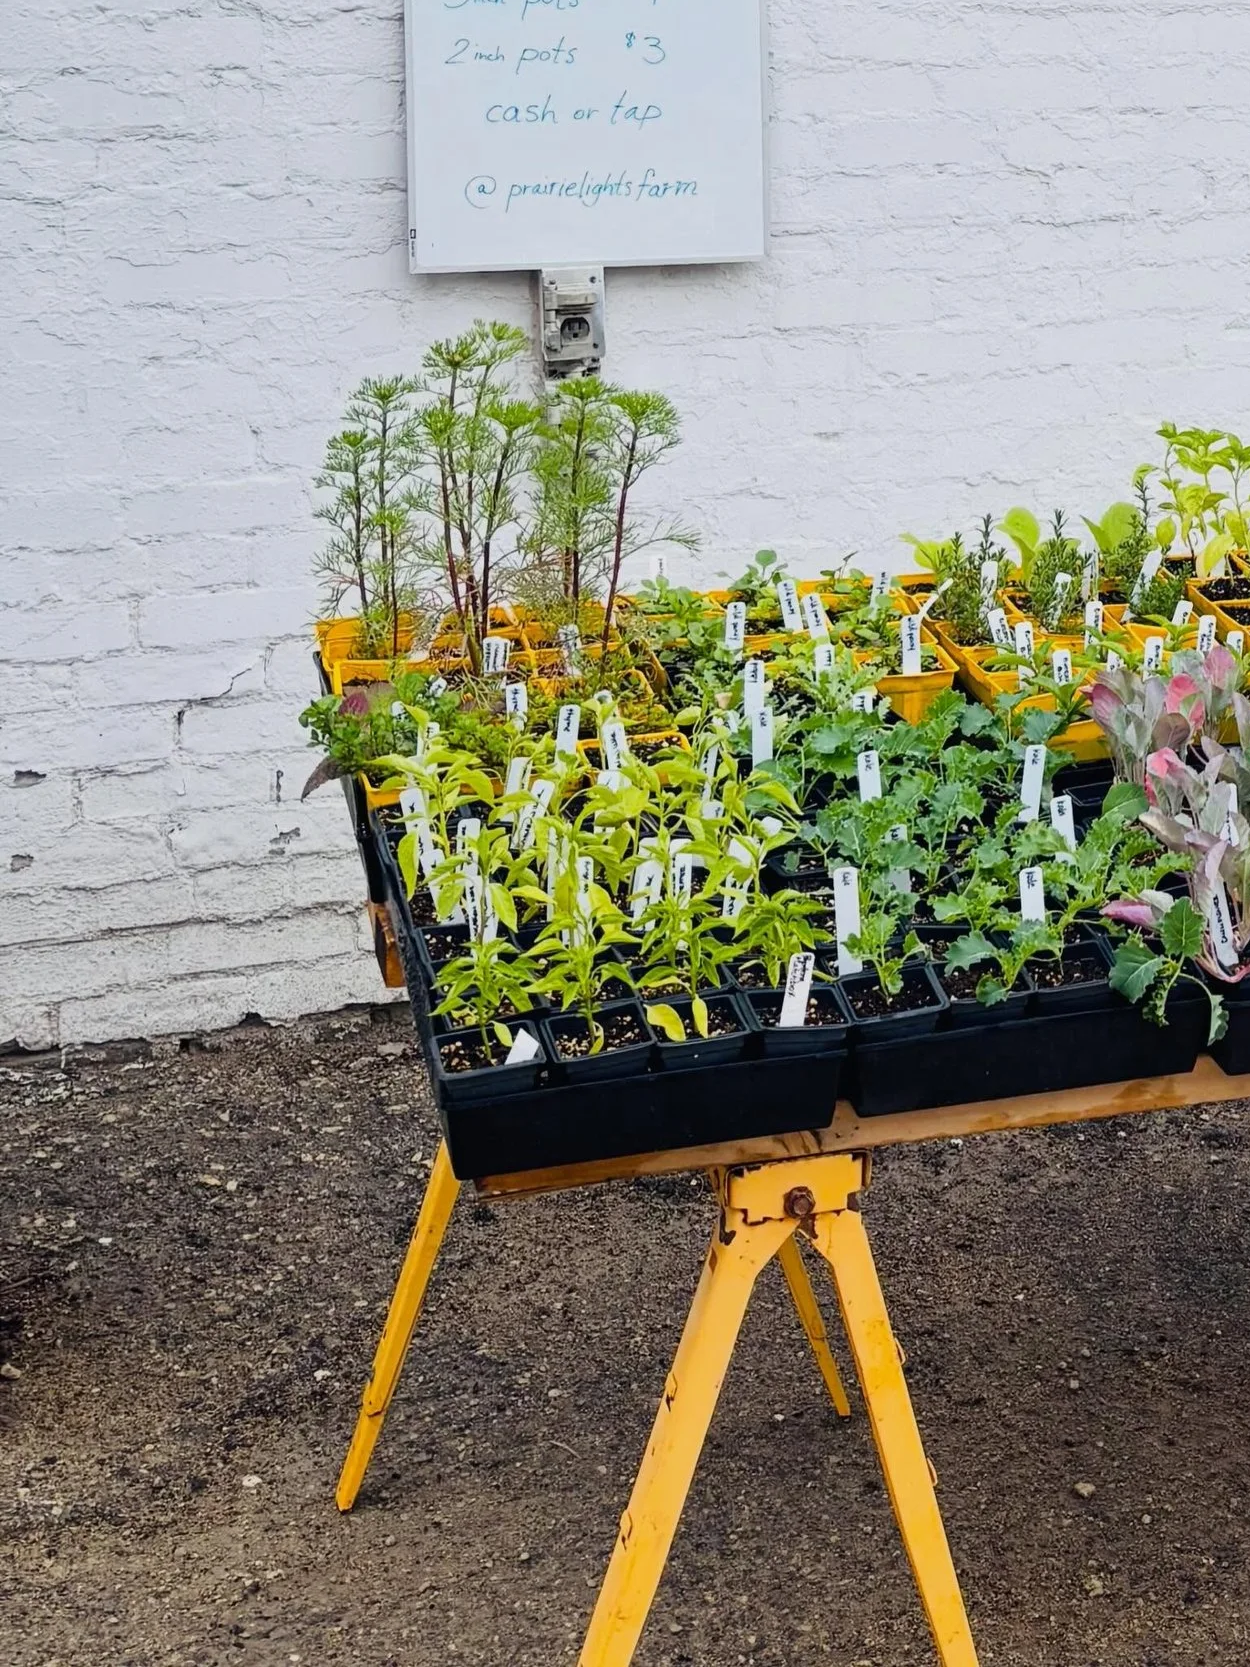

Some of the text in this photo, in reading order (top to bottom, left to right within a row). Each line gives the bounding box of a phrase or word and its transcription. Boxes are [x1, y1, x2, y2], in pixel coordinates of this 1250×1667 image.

[515, 36, 578, 75] pots
[625, 31, 667, 65] $3
[485, 90, 663, 128] cash or tap
